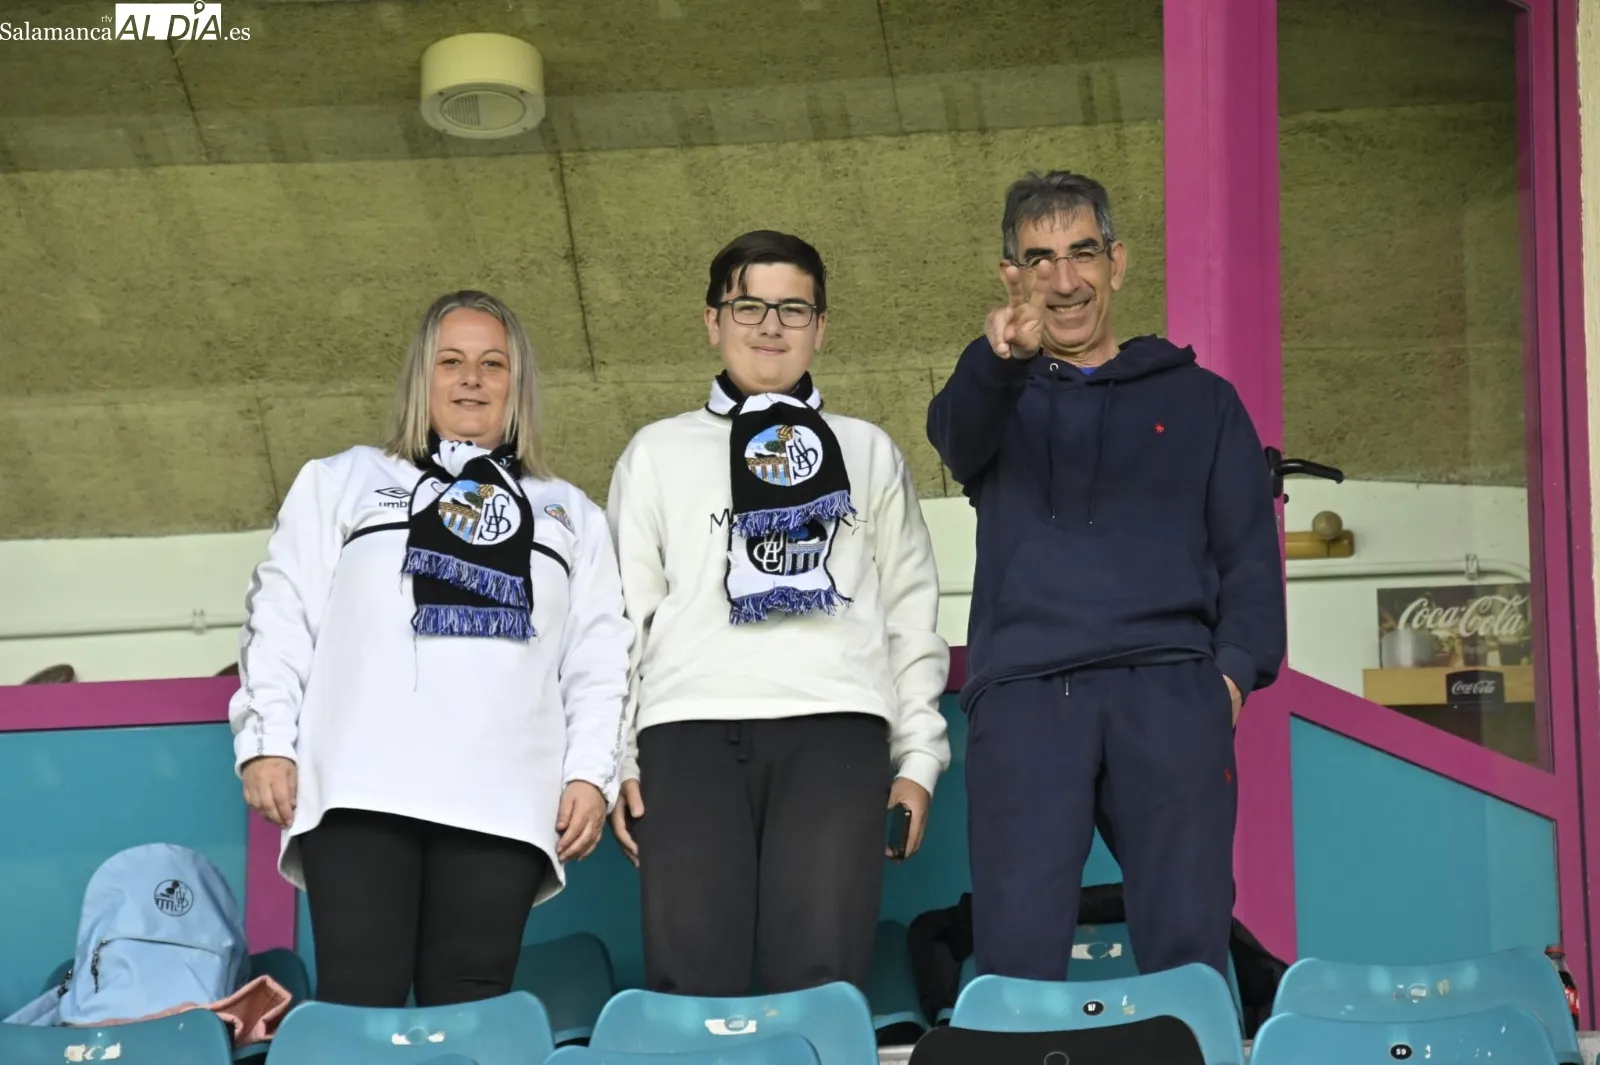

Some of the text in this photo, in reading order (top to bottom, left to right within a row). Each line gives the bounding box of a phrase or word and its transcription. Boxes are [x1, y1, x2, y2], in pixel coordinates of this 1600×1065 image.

[378, 500, 409, 508] umb
[1397, 595, 1530, 637] Coca-Cola
[1451, 680, 1496, 695] Coca-Cola
